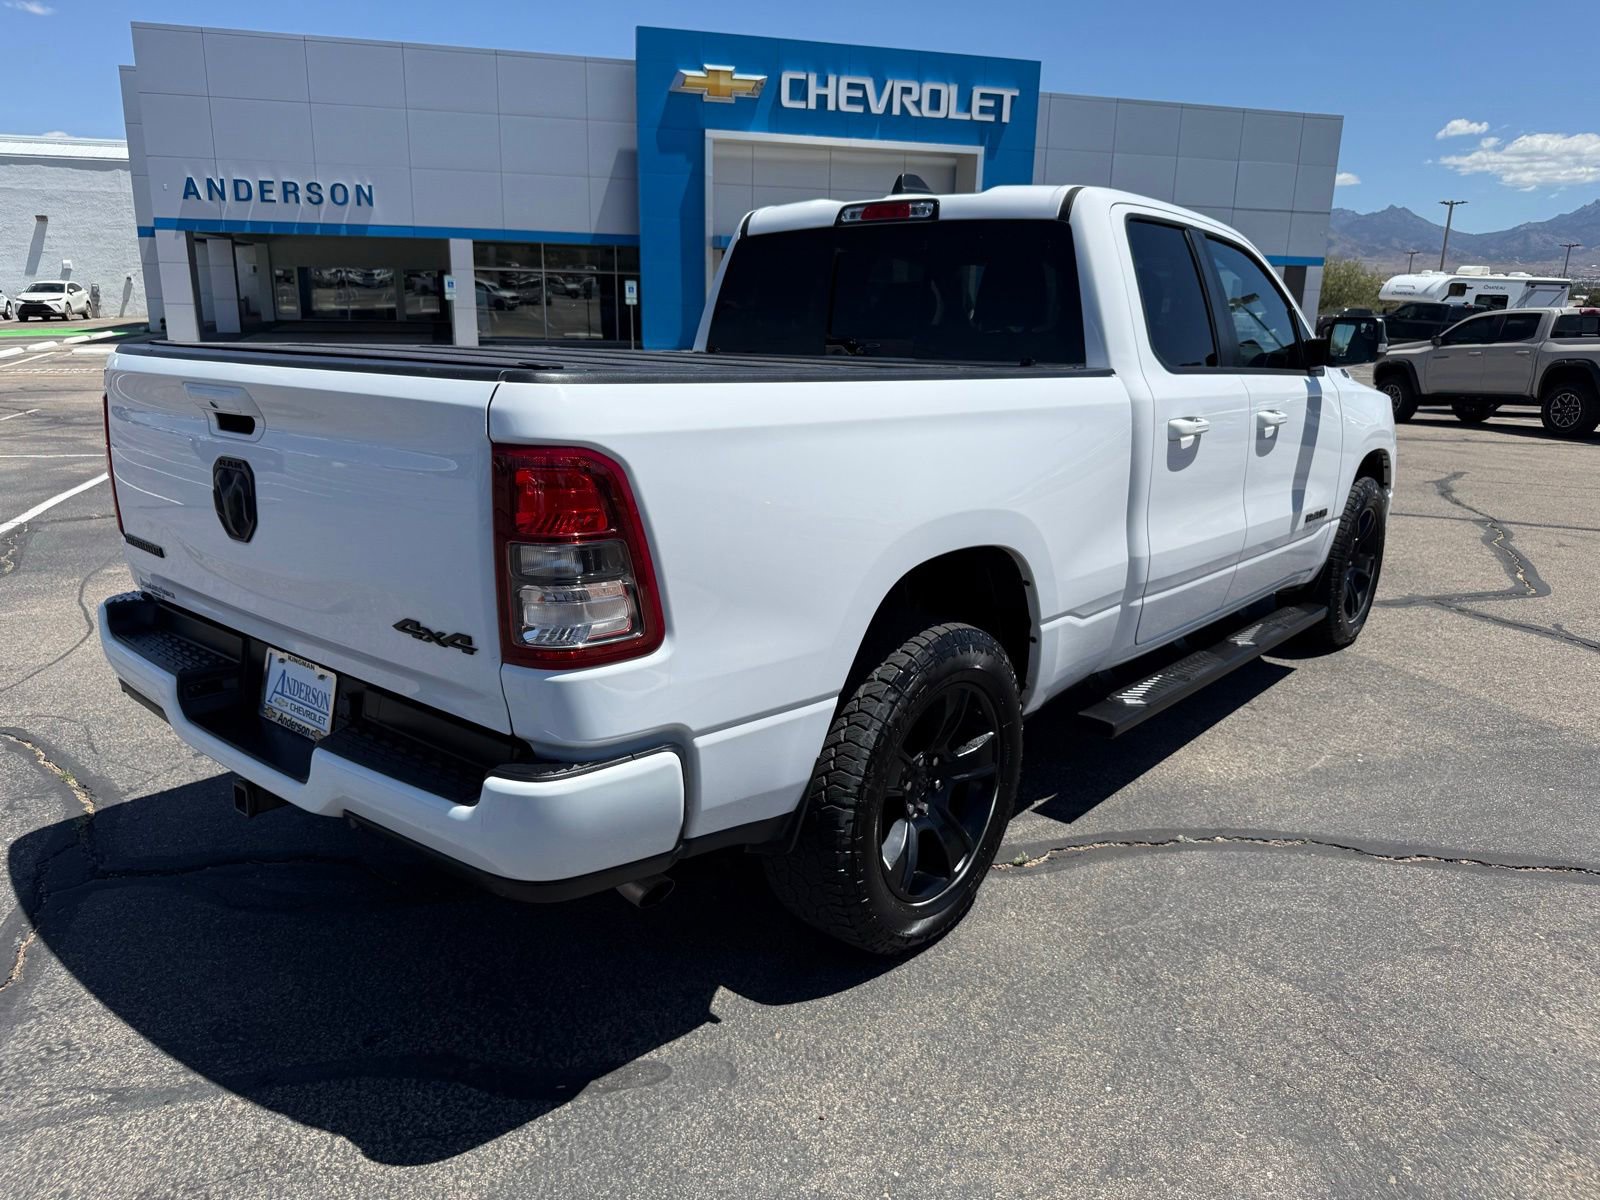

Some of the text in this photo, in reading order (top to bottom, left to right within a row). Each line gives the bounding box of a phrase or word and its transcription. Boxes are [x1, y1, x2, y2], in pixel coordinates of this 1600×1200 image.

[781, 71, 1020, 123] CHEVROLET
[182, 176, 375, 207] ANDERSON
[287, 654, 316, 671] KINGMAN
[277, 712, 311, 737] Anderson
[289, 702, 327, 727] CHEVROLET
